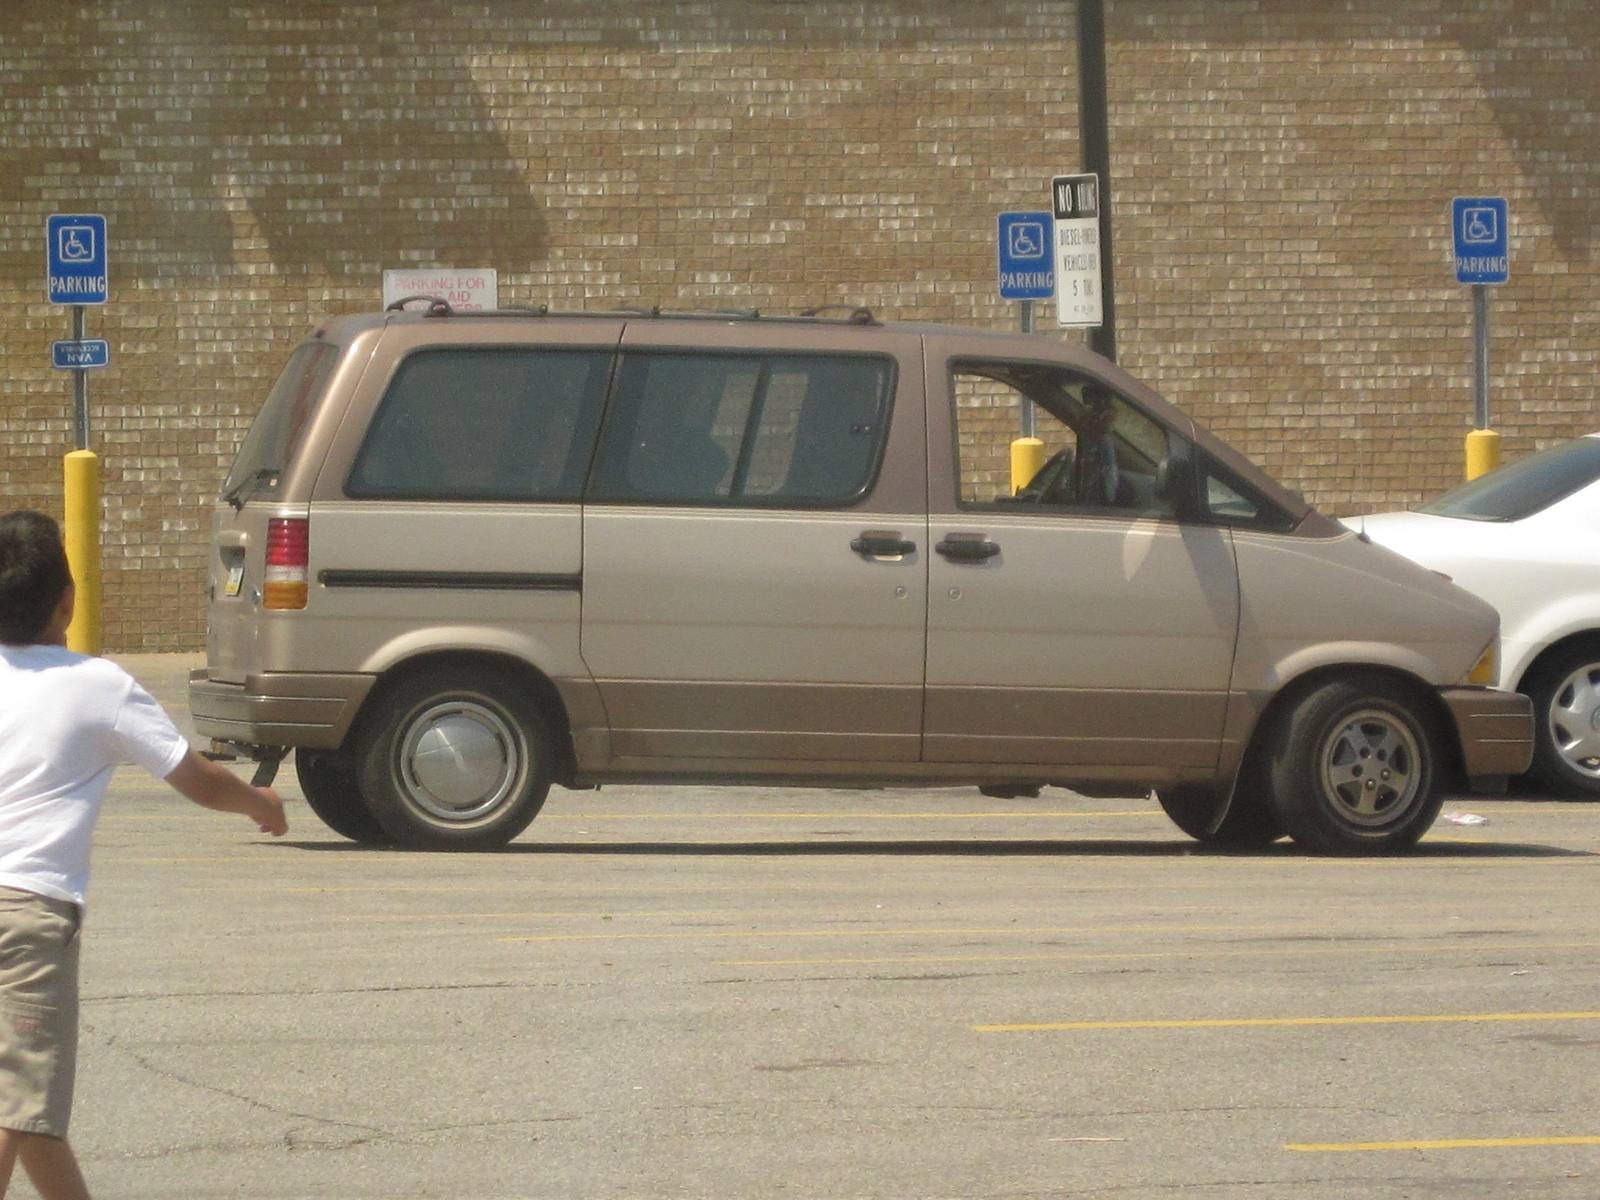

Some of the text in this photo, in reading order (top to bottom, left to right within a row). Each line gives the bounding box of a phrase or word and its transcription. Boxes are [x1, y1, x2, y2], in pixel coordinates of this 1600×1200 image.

[1058, 184, 1073, 212] NO
[1456, 256, 1507, 273] PARKING
[50, 276, 105, 293] PARKING
[394, 278, 485, 289] PARKING FOR
[1000, 272, 1053, 289] PARKING
[448, 291, 470, 302] AID
[67, 354, 93, 362] VAN
